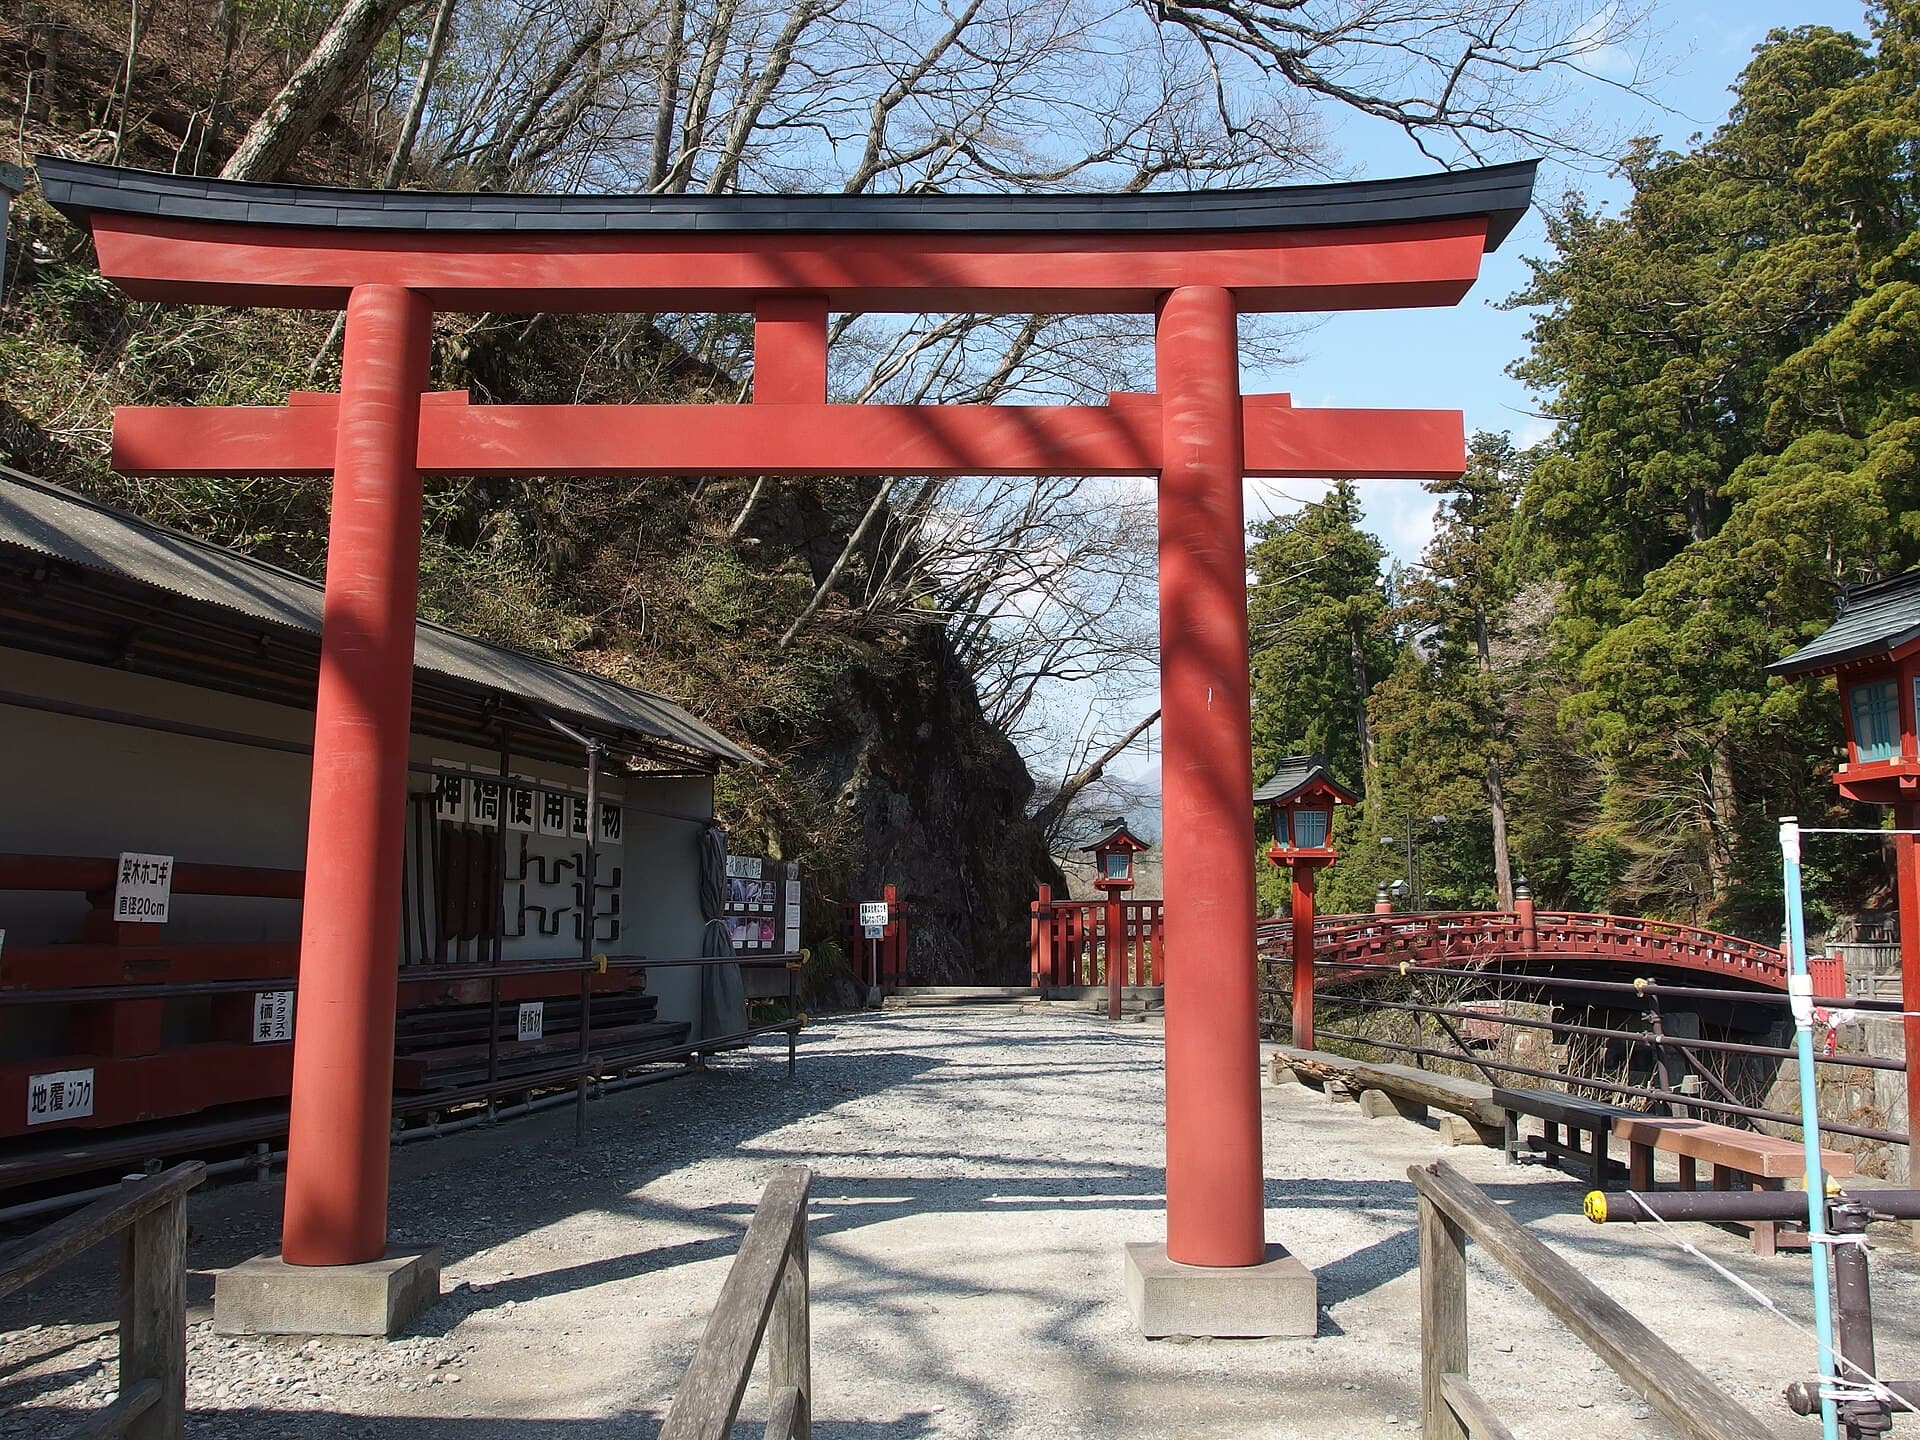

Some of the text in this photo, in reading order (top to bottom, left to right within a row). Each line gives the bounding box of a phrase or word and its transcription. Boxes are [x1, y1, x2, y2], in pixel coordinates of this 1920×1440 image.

[121, 858, 169, 886] 架木ホコギ
[119, 896, 165, 916] 直径20cm
